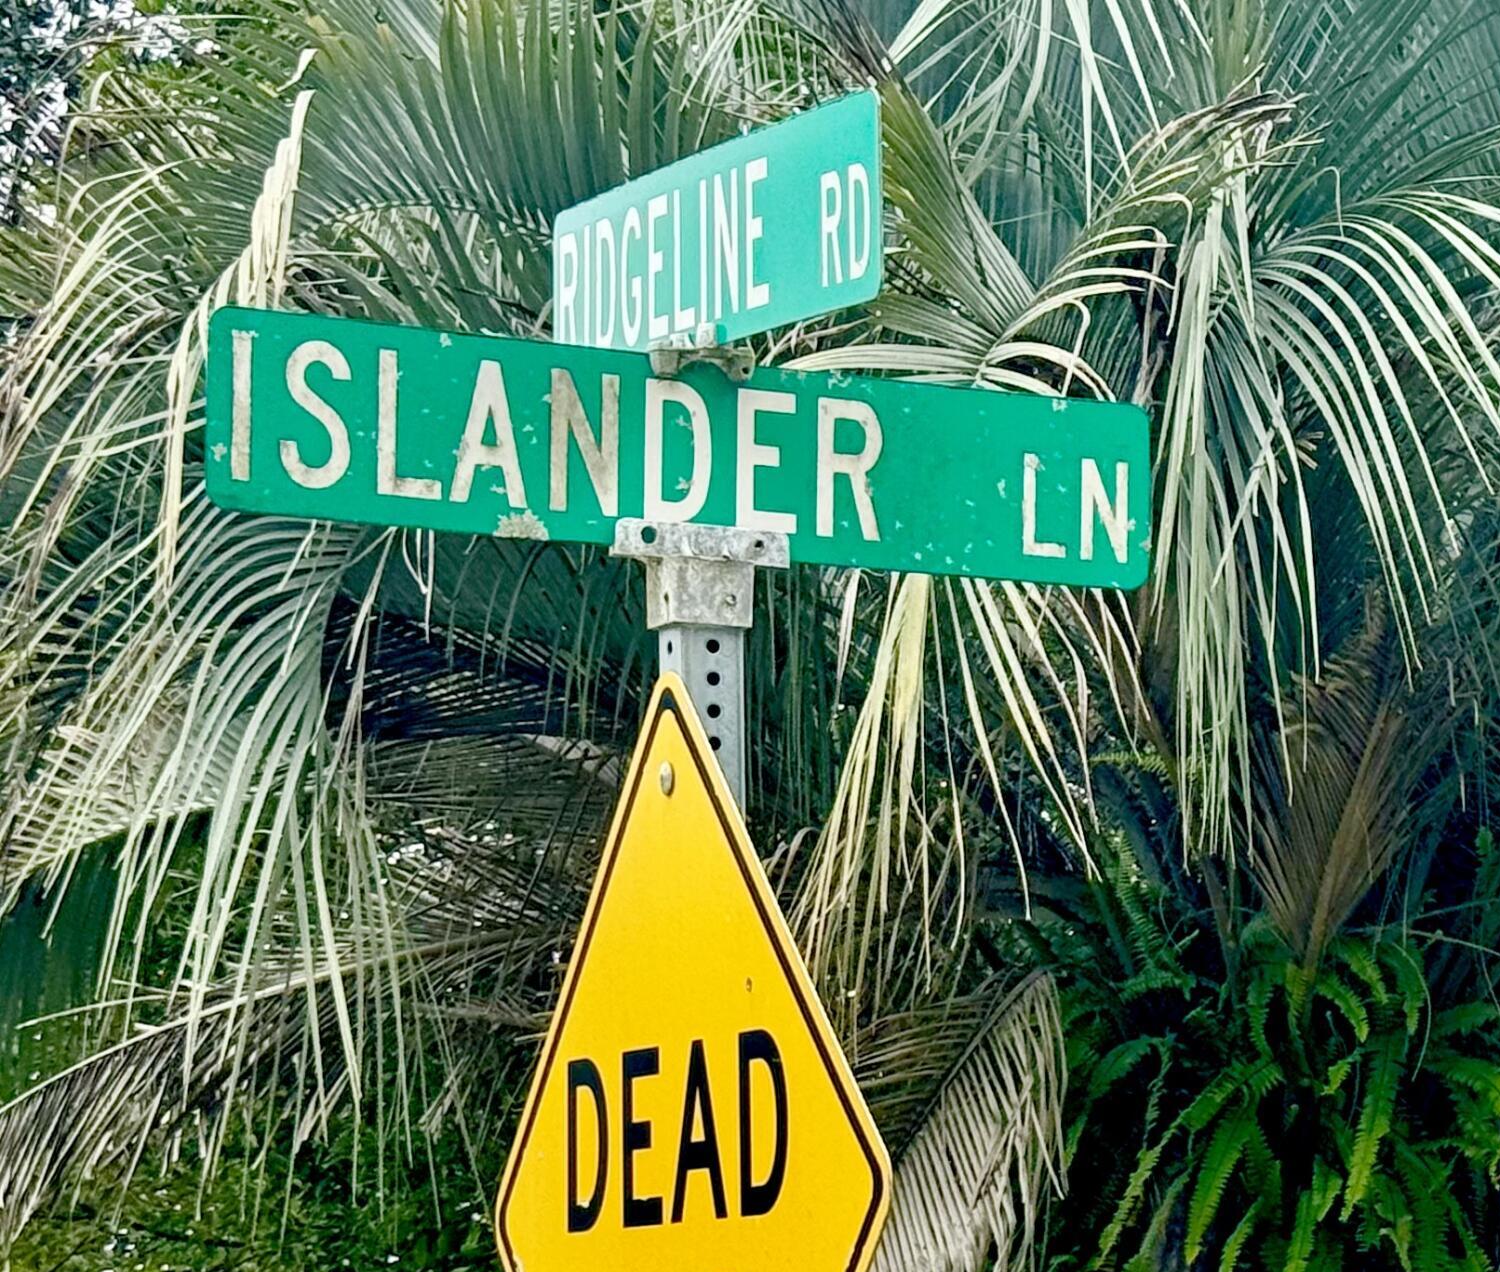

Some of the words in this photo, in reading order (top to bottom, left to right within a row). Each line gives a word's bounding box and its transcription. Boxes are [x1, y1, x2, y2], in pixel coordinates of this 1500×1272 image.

[558, 157, 770, 347] RIDGELINE
[820, 163, 871, 288] RD
[230, 330, 884, 543] ISLANDER
[1022, 452, 1130, 565] LN
[567, 1029, 789, 1233] DEAD
